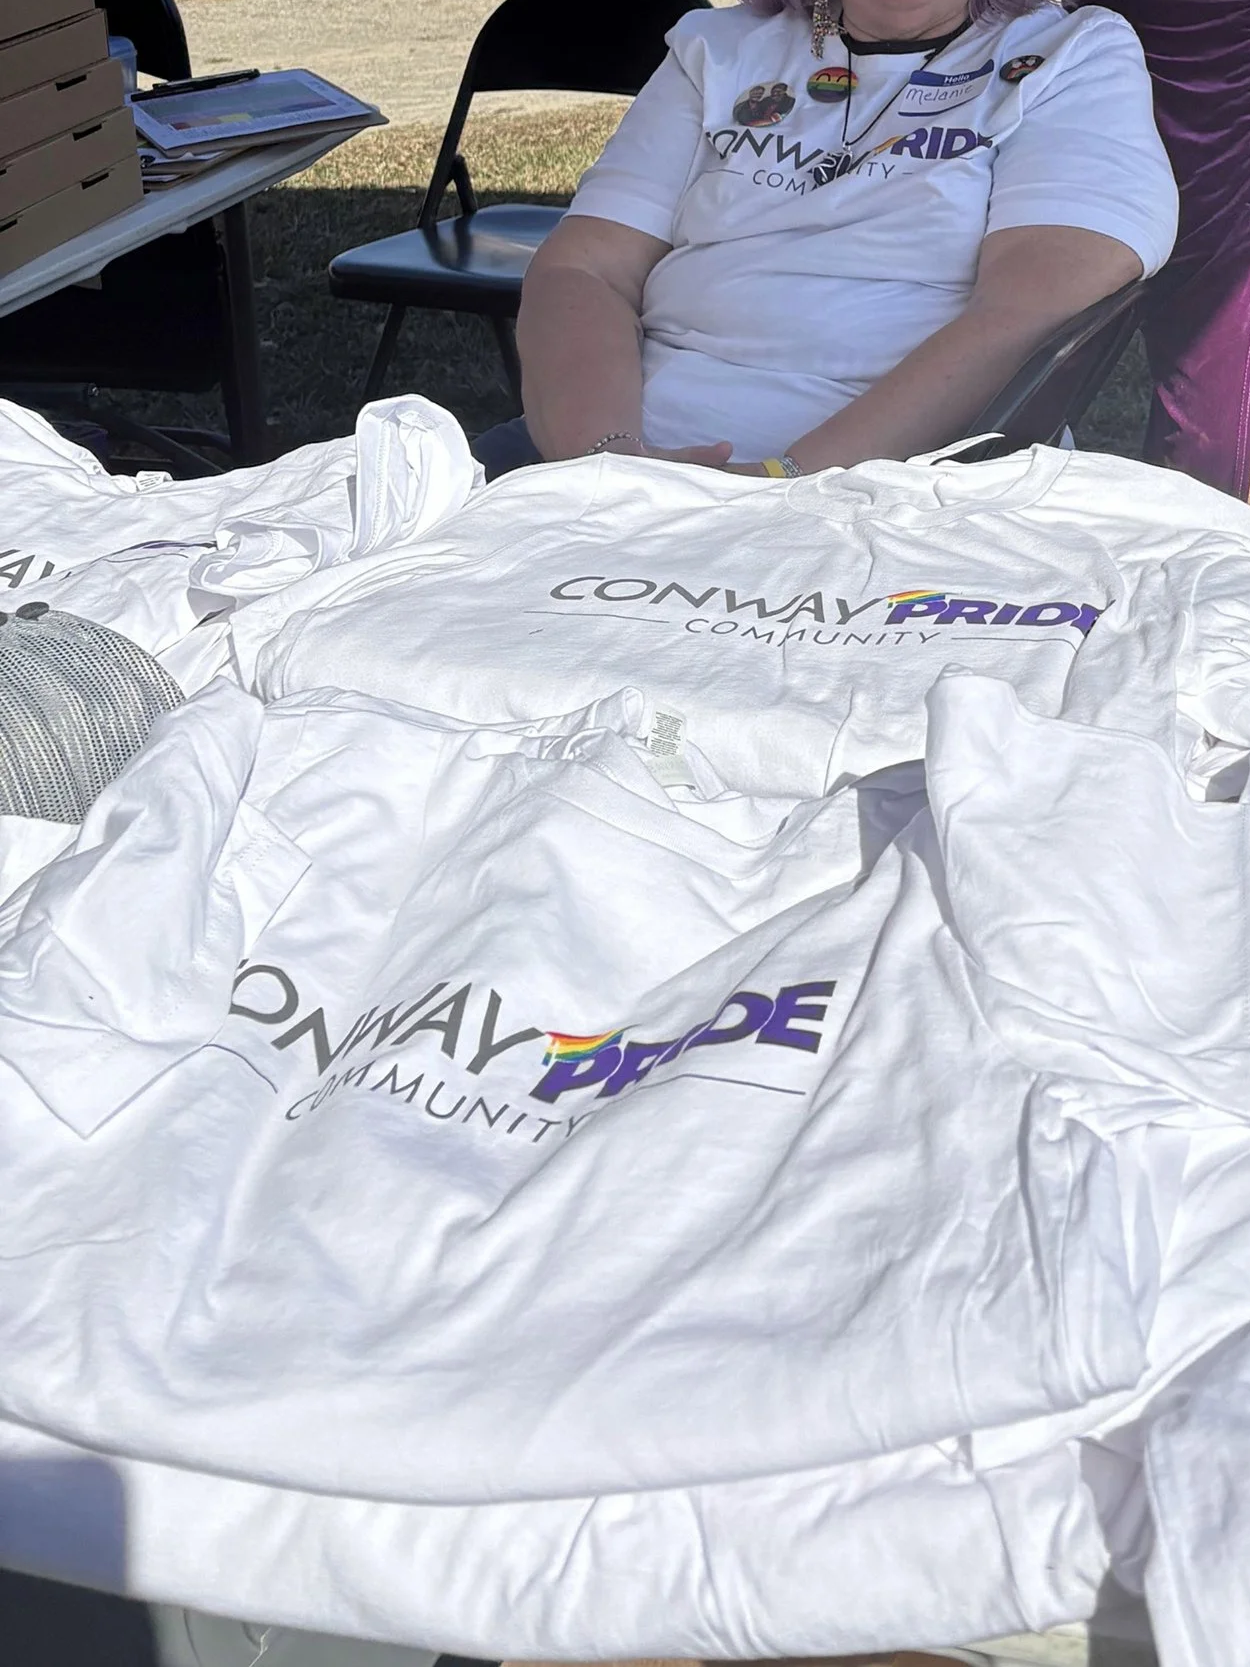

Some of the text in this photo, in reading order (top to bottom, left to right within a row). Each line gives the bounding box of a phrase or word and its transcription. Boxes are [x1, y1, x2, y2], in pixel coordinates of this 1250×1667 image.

[905, 84, 974, 106] Melanie
[943, 73, 970, 84] Hello
[890, 126, 992, 160] RID
[549, 574, 884, 626] CONWAY
[684, 617, 943, 647] COMMUNITY
[228, 958, 546, 1077] ONWAY
[285, 1059, 592, 1144] COMMUNITY
